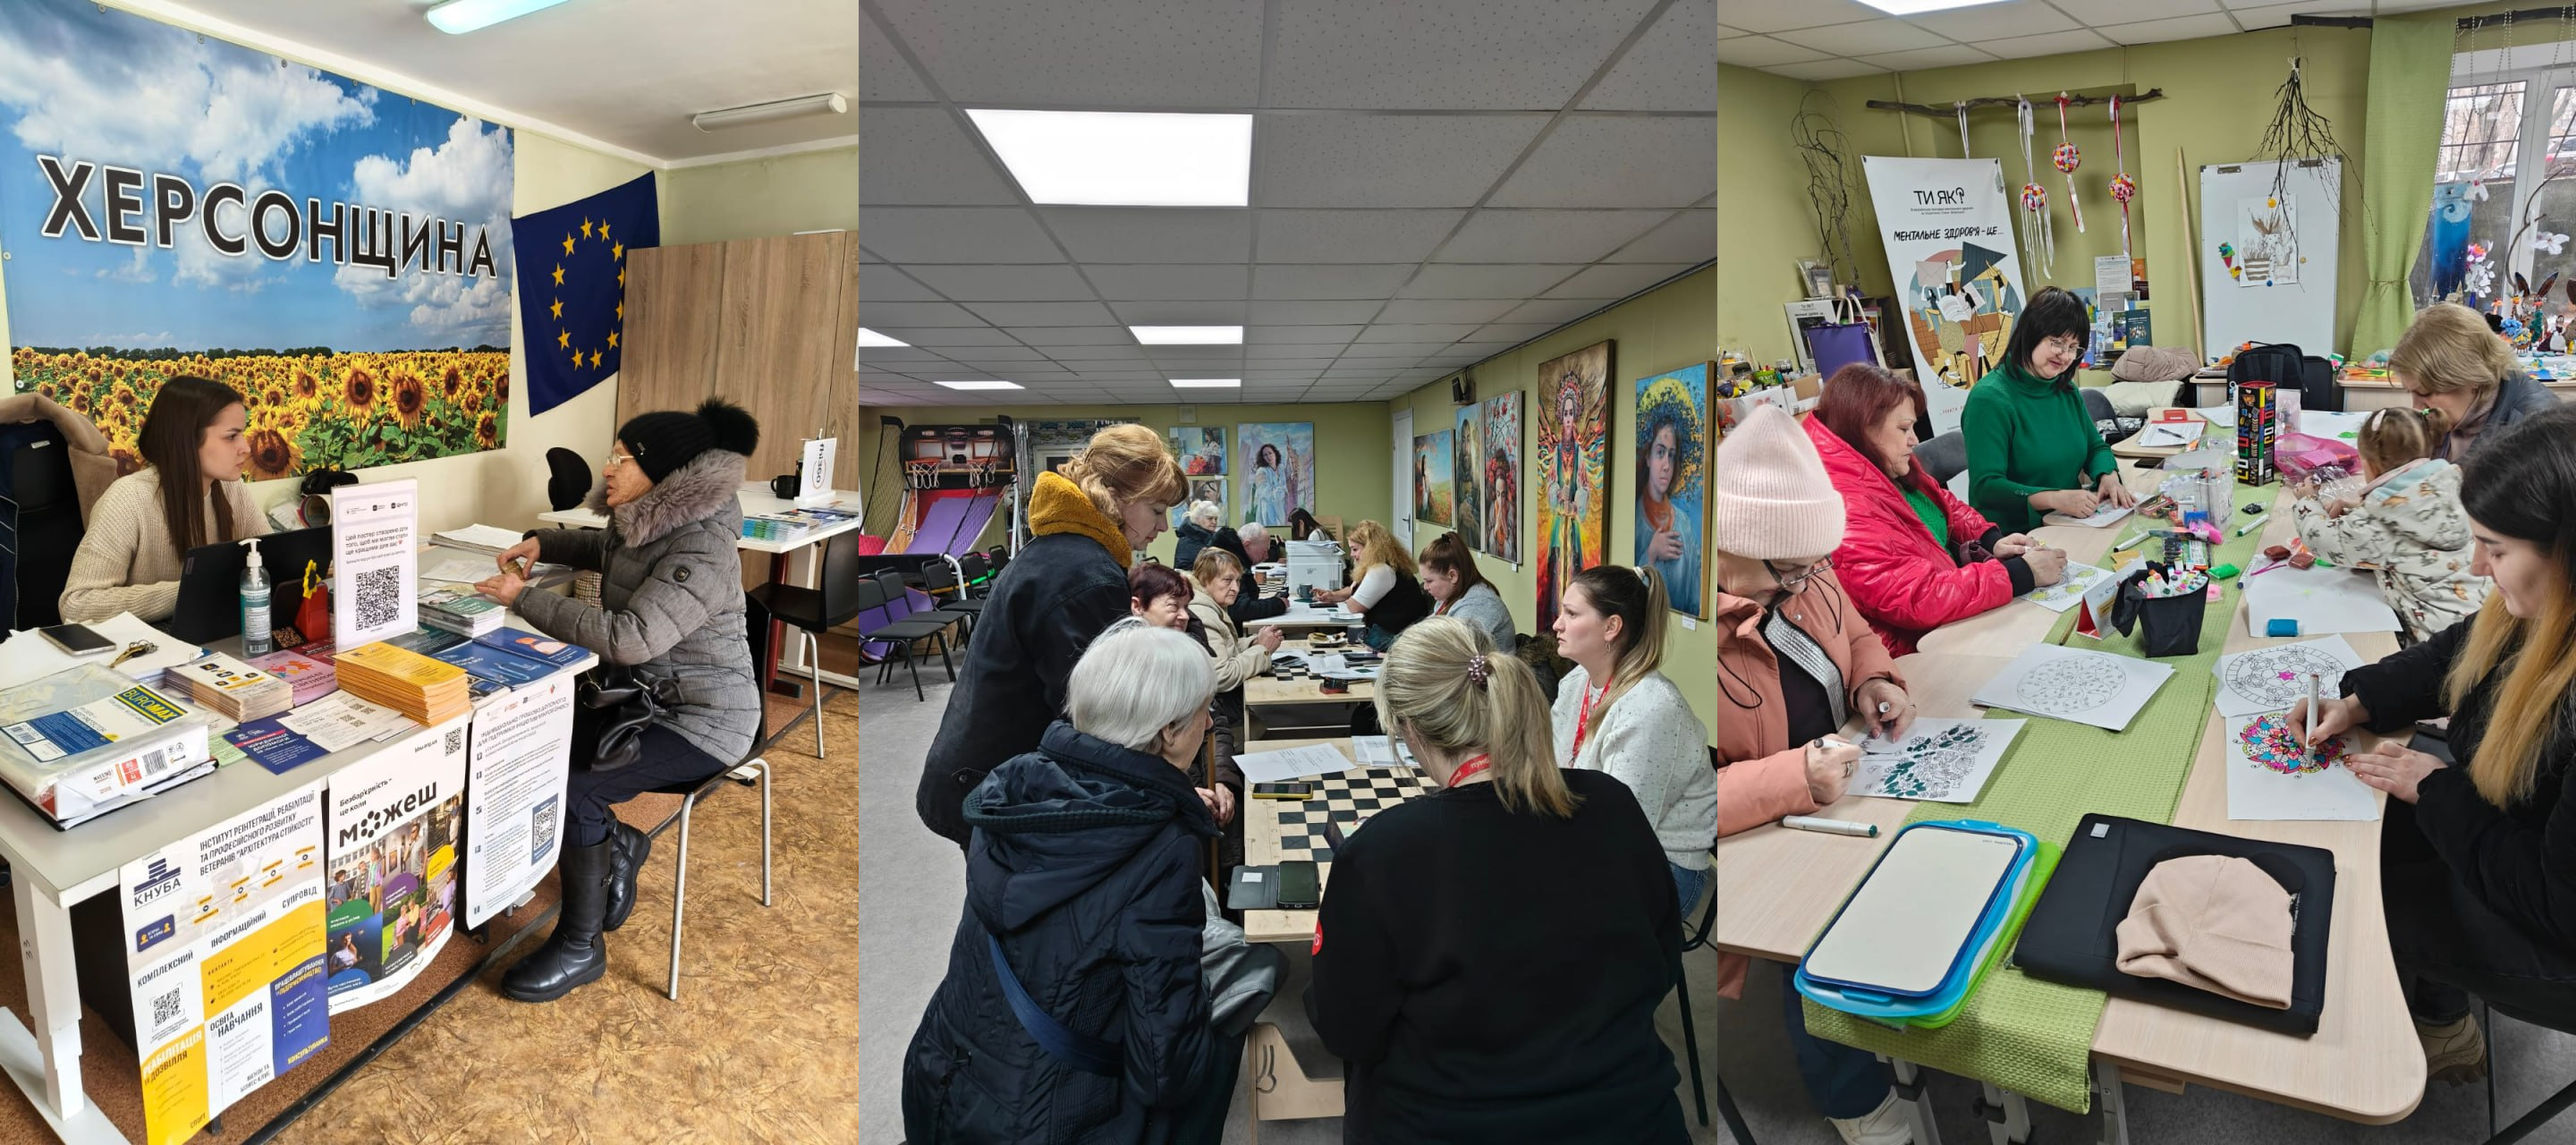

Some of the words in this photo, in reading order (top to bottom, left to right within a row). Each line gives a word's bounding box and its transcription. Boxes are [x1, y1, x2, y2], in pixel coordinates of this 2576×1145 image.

[1913, 191, 1935, 205] ТИ
[1937, 187, 1965, 205] ЯК?
[37, 154, 498, 280] ХЕРСОНЩИНА
[1894, 229, 1940, 242] МЕНТАЛЬНЕ
[1944, 226, 1979, 240] ЗДОРОВ'Я
[357, 531, 376, 539] постер
[376, 527, 399, 537] створено
[359, 539, 370, 547] щоб
[123, 689, 177, 721] BUROMAX
[340, 780, 388, 807] Безбар'єрність
[199, 829, 233, 852] ІНСТИТУТ
[233, 808, 276, 836] РЕІНТЕГРАЦІЇ,
[277, 790, 315, 816] РЕАБІЛІТАЦІЇ
[339, 808, 349, 817] це
[350, 800, 367, 812] коли
[200, 853, 208, 863] ТА
[265, 812, 297, 834] РОЗВИТКУ
[199, 852, 235, 876] ВЕТЕРАНІВ
[134, 878, 182, 907] КНУБА
[282, 886, 318, 909] СУПРОВІД
[211, 910, 267, 948] ІНФОРМАЦІЙНИЙ
[137, 949, 193, 988] КОМПЛЕКСНИЙ
[210, 1011, 234, 1031] ОСВІТА
[217, 1002, 263, 1038] НАВЧАННЯ
[142, 1030, 202, 1080] РЕАБІЛІТАЦІЯ
[150, 1050, 188, 1083] ДОЗВІЛЛЯ
[190, 1112, 206, 1130] СПОРТ
